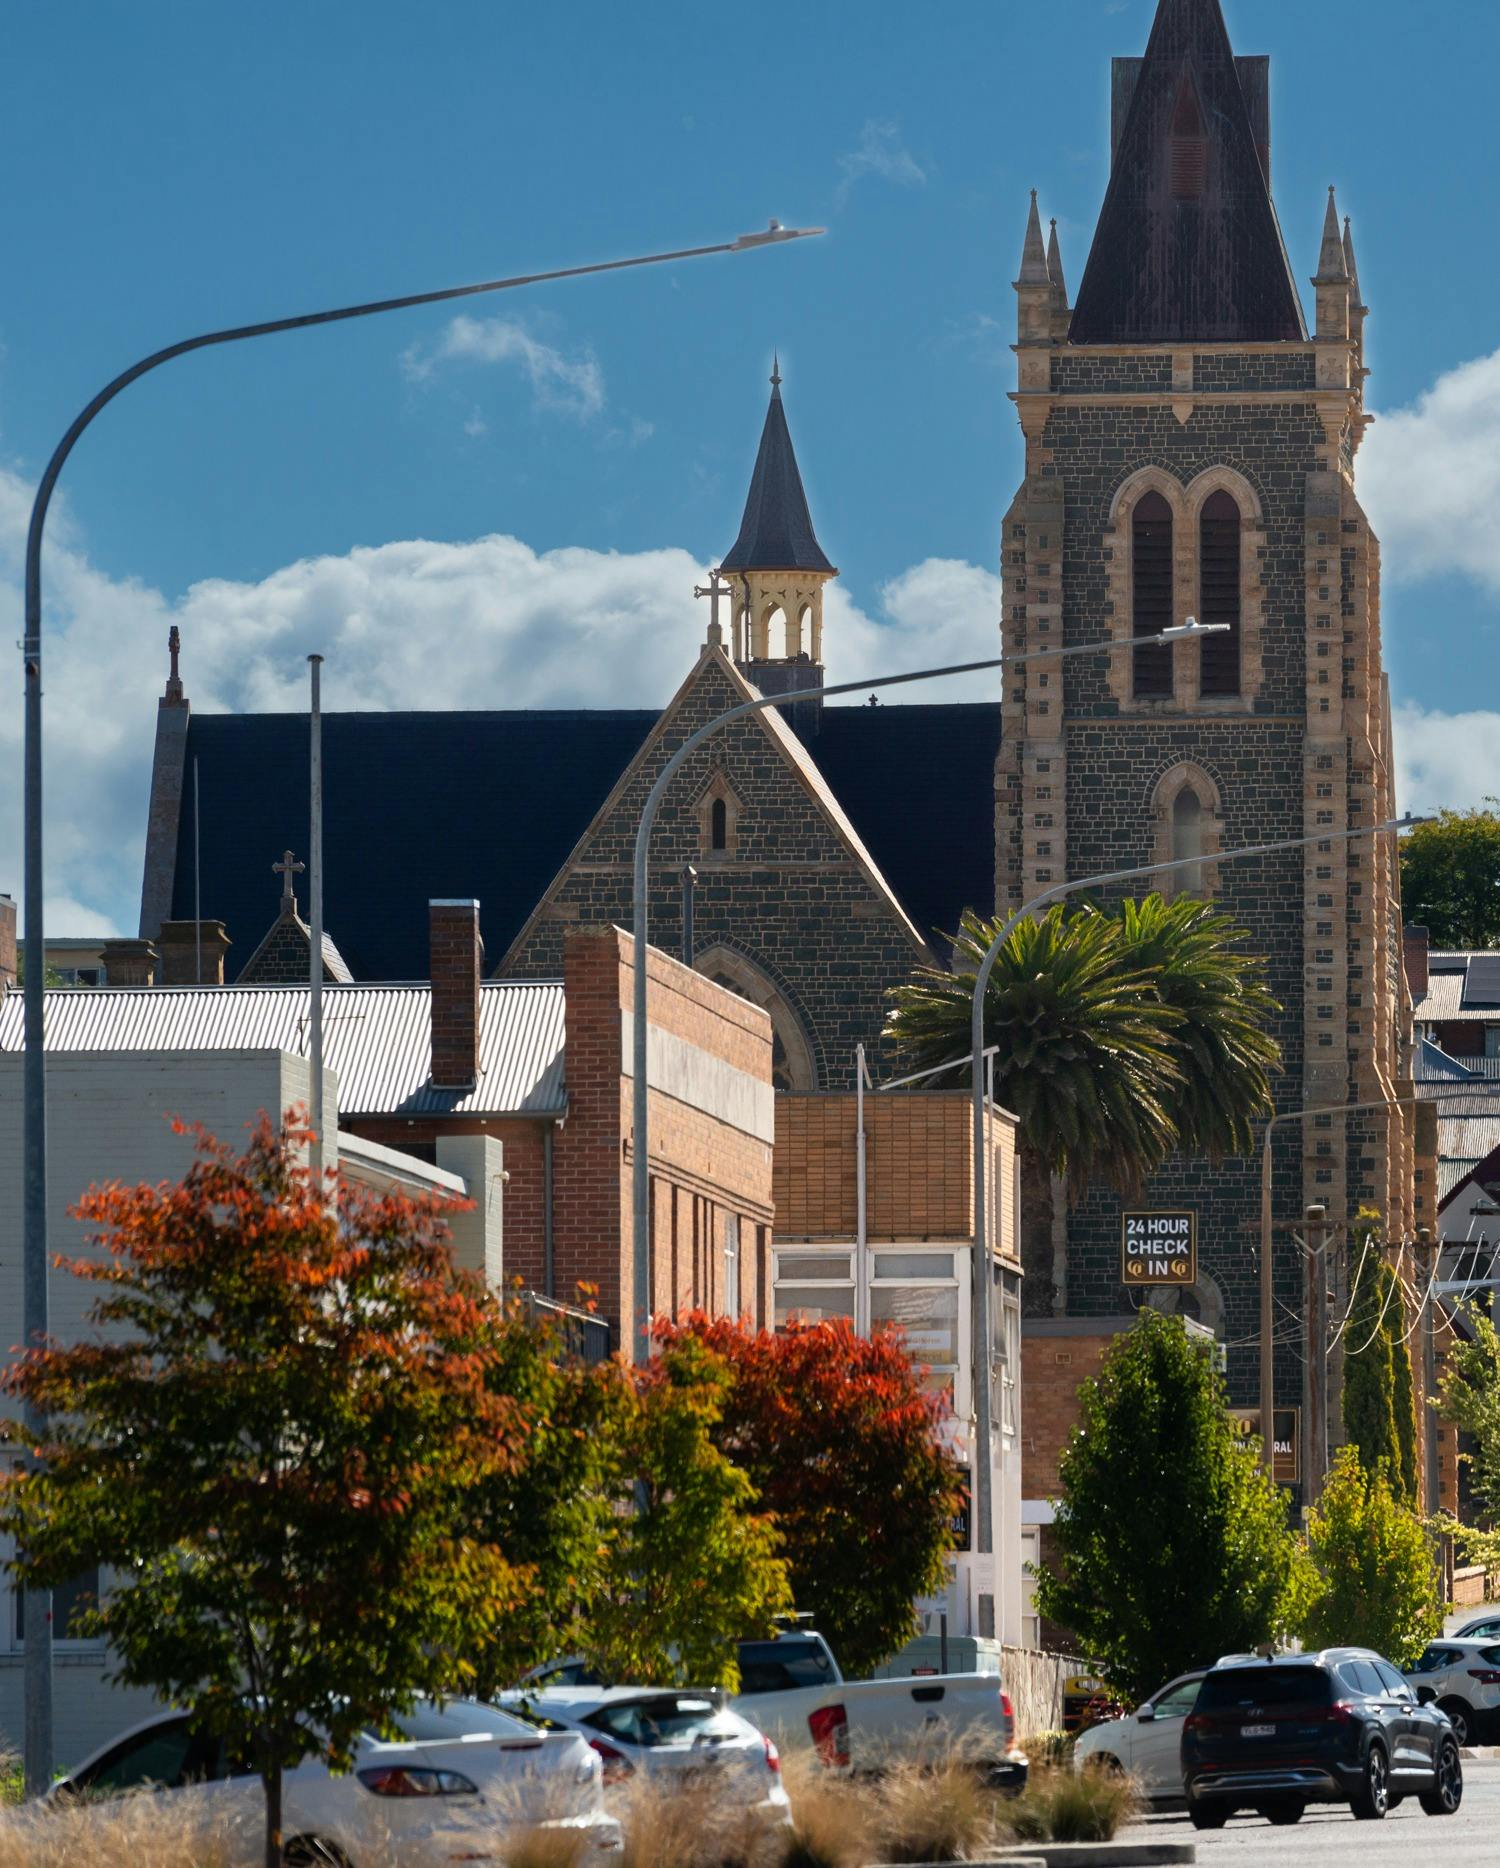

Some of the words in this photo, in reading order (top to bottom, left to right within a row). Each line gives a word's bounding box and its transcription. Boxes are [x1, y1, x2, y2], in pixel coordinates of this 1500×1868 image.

[1127, 1219, 1145, 1234] 24
[1147, 1219, 1189, 1234] HOUR
[1127, 1239, 1189, 1255] CHECK
[1148, 1260, 1168, 1276] IN
